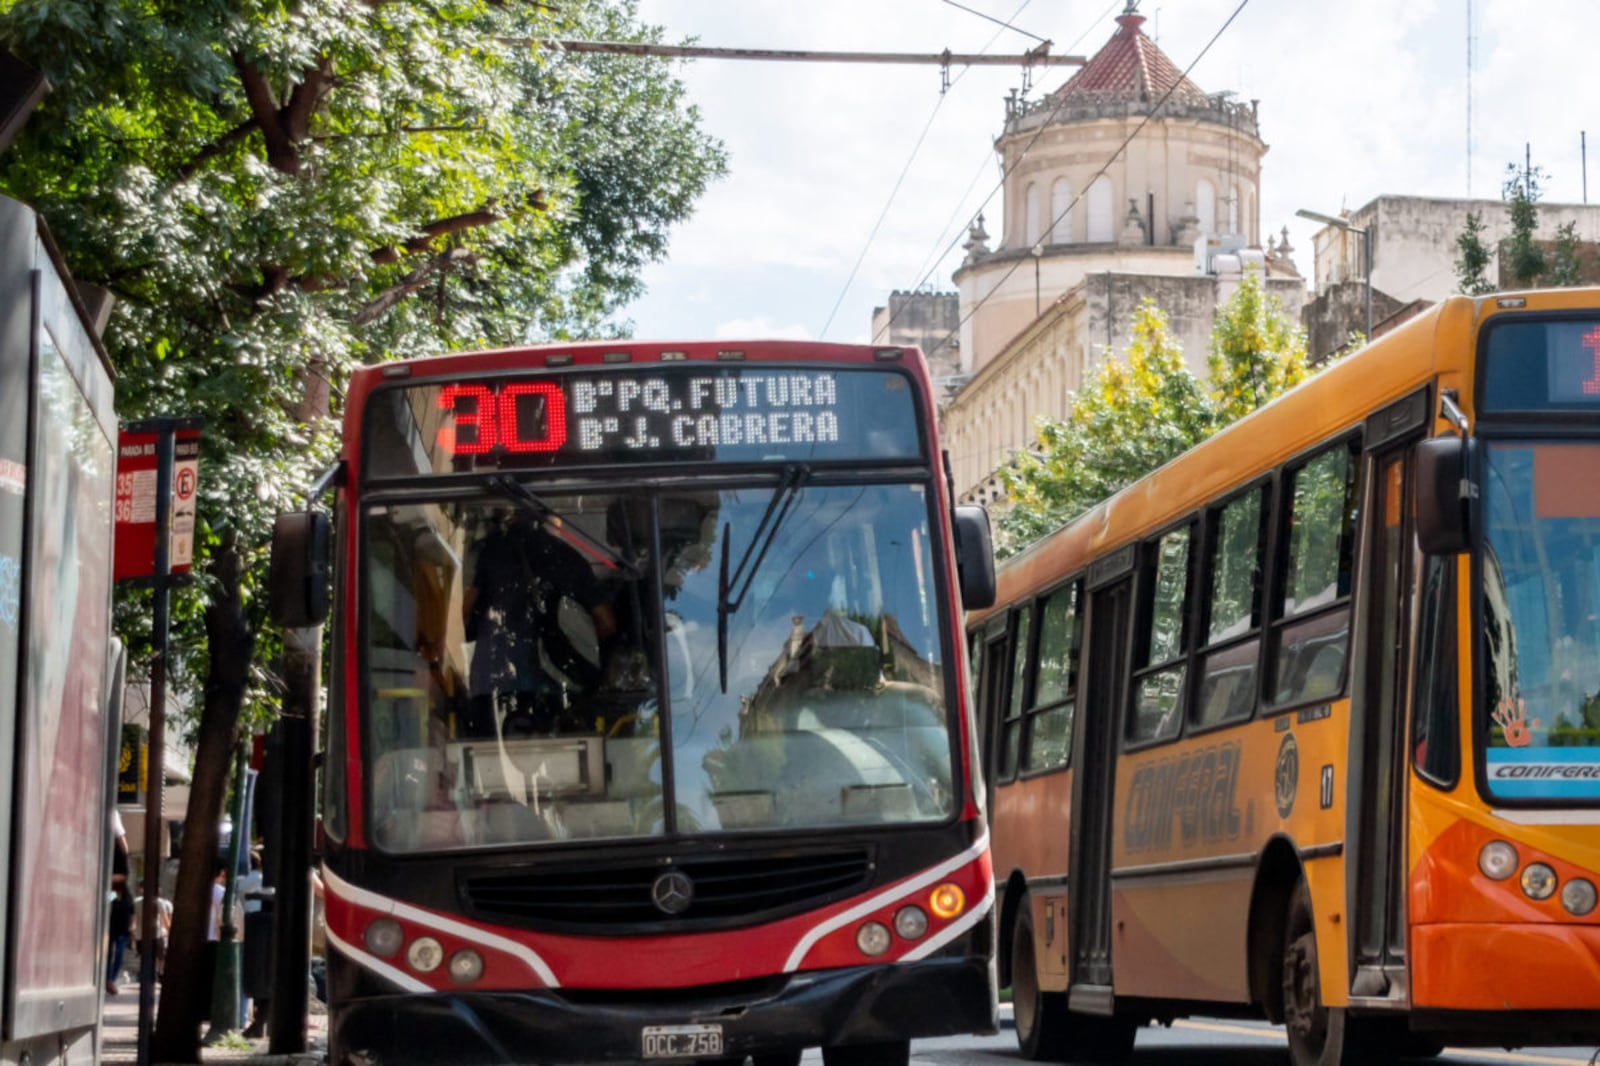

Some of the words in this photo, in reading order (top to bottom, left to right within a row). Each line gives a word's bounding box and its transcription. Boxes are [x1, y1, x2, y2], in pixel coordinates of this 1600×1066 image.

[690, 373, 836, 410] FUTURA
[435, 383, 567, 454] 30
[672, 410, 838, 447] CABRERA
[117, 472, 133, 496] 35
[116, 498, 131, 521] 36
[646, 1035, 677, 1056] OCC
[687, 1033, 719, 1053] 758
